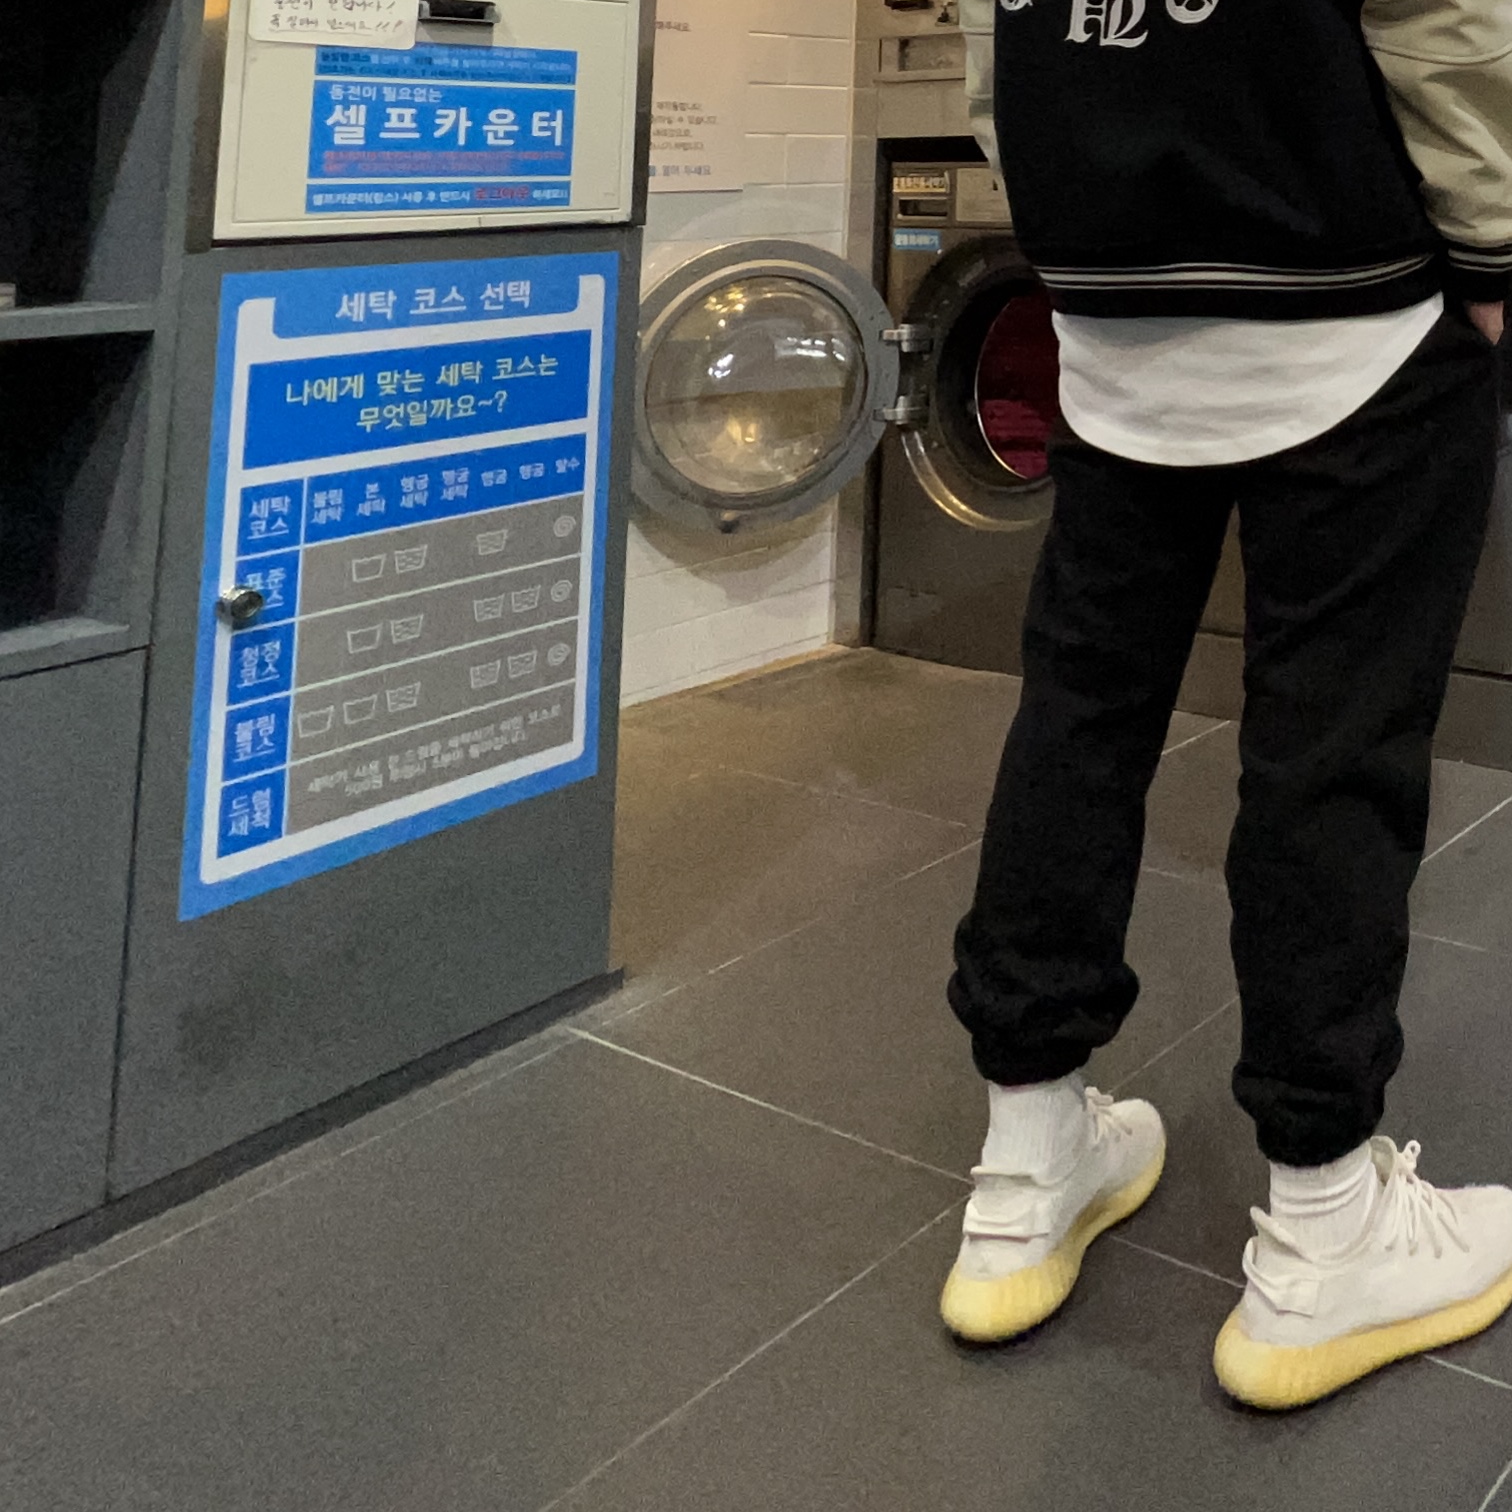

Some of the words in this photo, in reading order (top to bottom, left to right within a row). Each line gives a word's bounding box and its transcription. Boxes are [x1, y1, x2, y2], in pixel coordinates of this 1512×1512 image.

[328, 86, 378, 102] 동전이
[382, 88, 443, 103] 필요없는
[336, 289, 396, 323] 세탁
[409, 285, 468, 316] 코스
[480, 279, 532, 309] 선택
[286, 374, 365, 407] 나에게
[376, 369, 425, 397] 맞는
[436, 361, 483, 387] 세탁
[492, 354, 559, 381] 코스는
[356, 390, 508, 434] 무엇일까요~?
[249, 494, 292, 520] 세탁
[246, 518, 290, 540] 코스
[240, 640, 282, 667] 청정
[237, 664, 281, 688] 코스
[234, 713, 277, 741] 불림
[233, 737, 276, 762] 코스
[231, 787, 272, 817] 드럼
